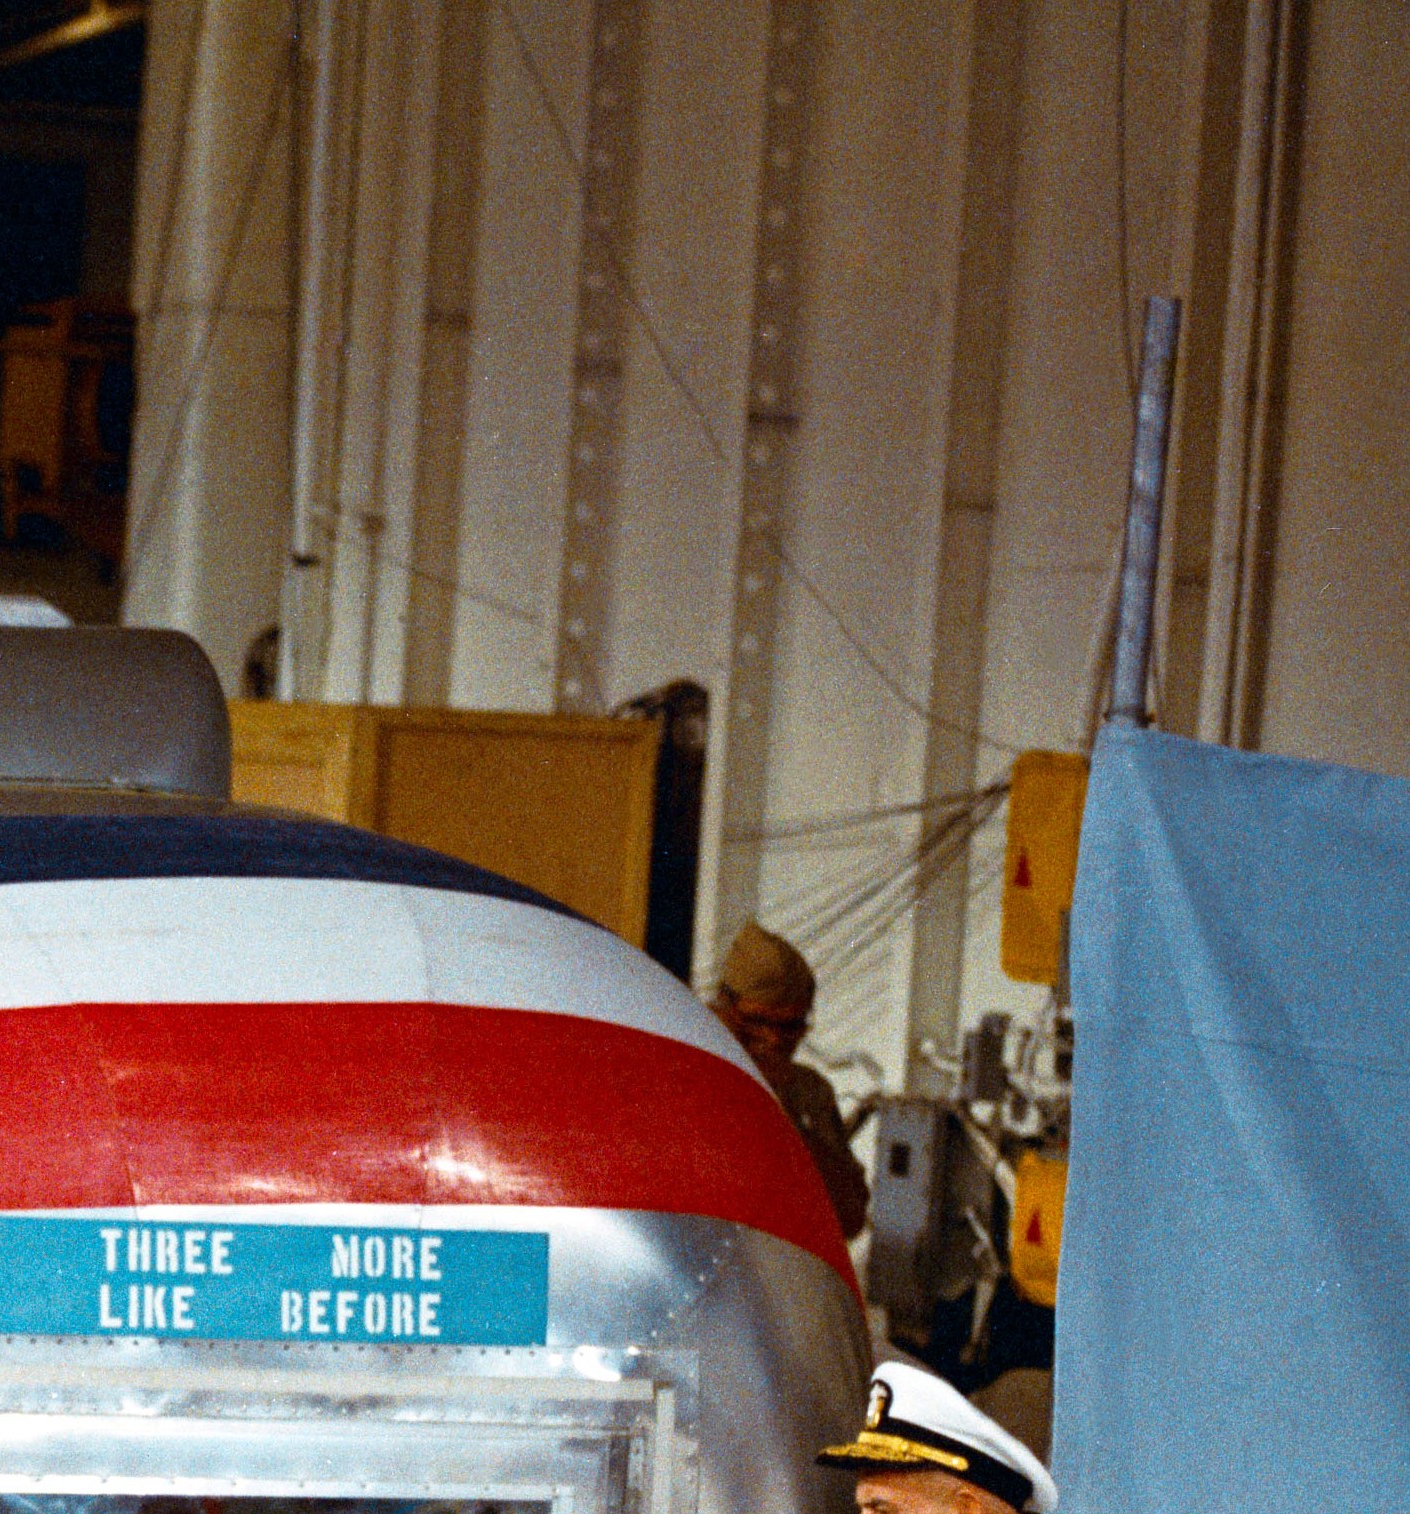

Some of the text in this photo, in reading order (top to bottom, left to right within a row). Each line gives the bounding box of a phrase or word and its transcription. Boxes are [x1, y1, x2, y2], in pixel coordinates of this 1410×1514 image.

[100, 1228, 441, 1280] THREE MORE
[99, 1283, 440, 1336] LIKE BEFORE
